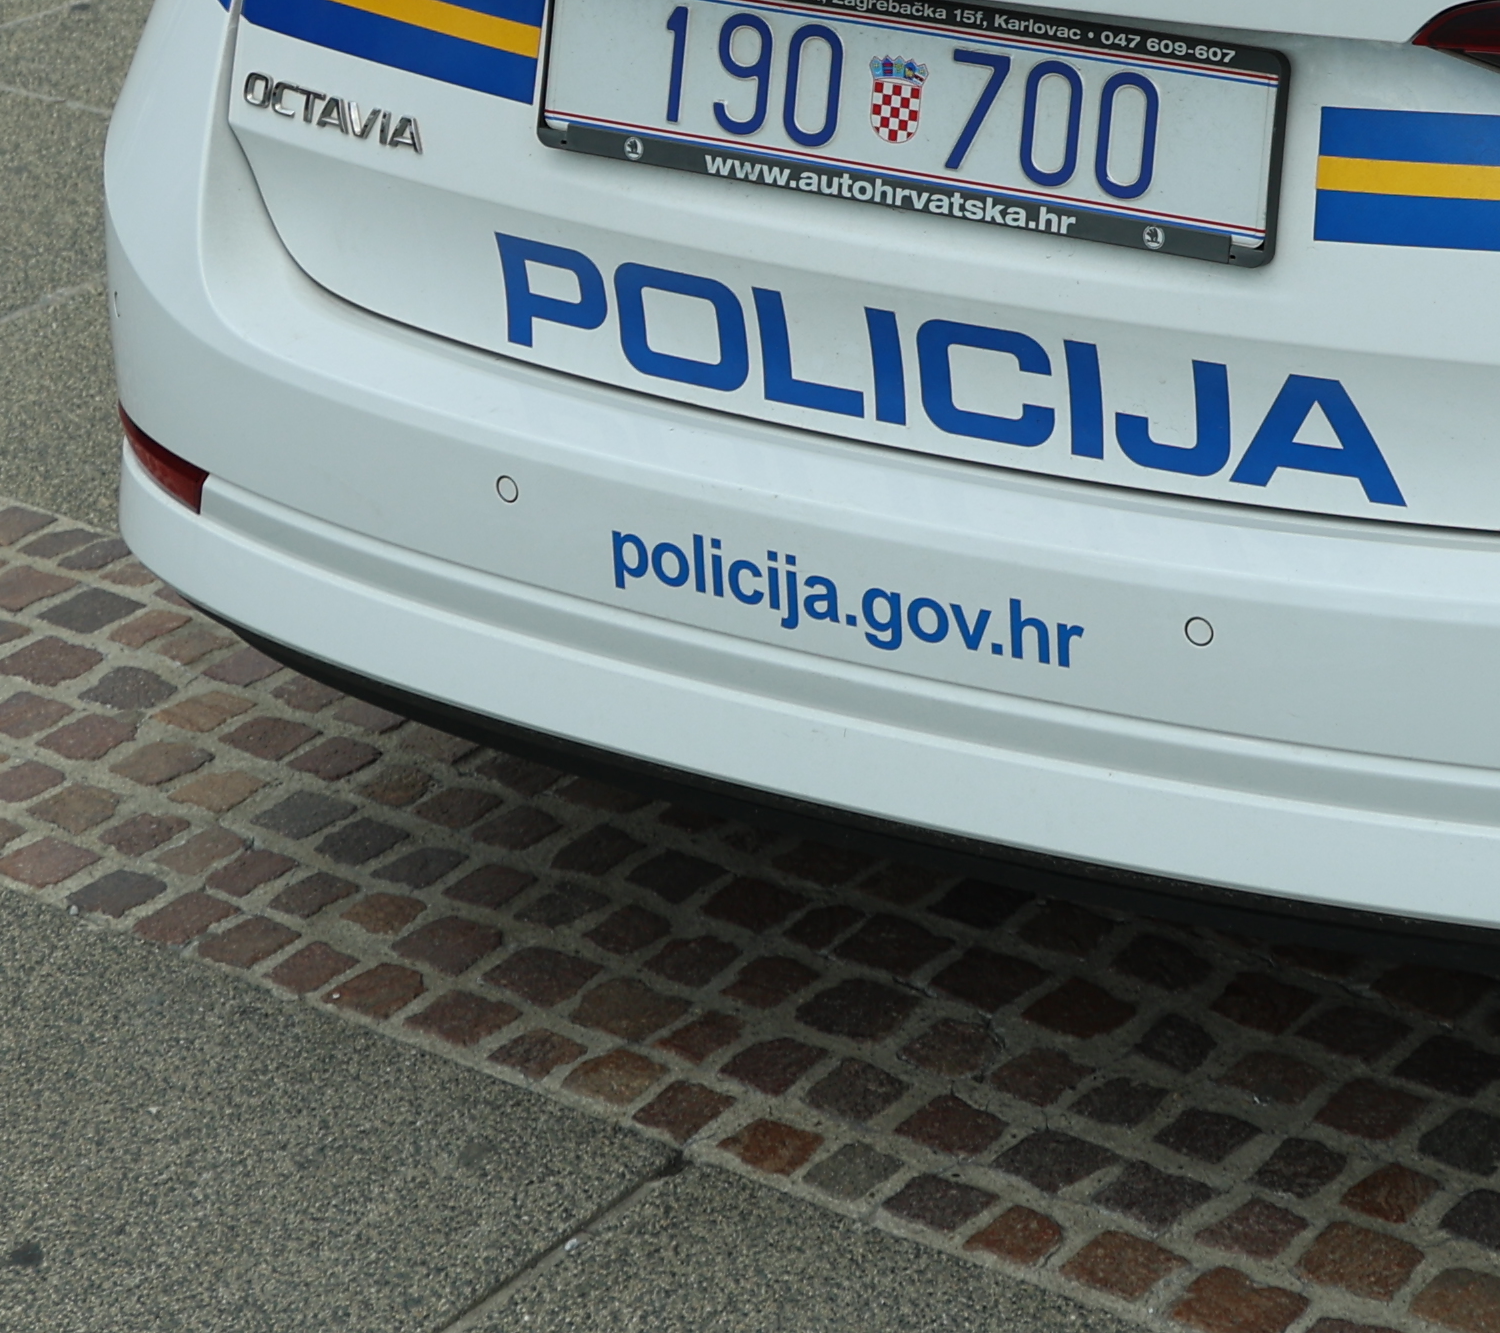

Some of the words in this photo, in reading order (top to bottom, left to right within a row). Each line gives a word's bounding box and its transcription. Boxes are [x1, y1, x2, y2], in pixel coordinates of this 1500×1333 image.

[953, 8, 988, 29] 15f,
[993, 13, 1082, 41] Karlovac
[1100, 30, 1141, 49] 047
[1146, 37, 1236, 64] 609-607
[244, 71, 424, 156] OCTAVIA
[666, 5, 846, 149] 190
[944, 47, 1161, 200] 700
[704, 153, 1077, 236] www.autohrvatska.hr
[493, 230, 1408, 508] POLICIJA
[611, 529, 1085, 669] policija.gov.hr
